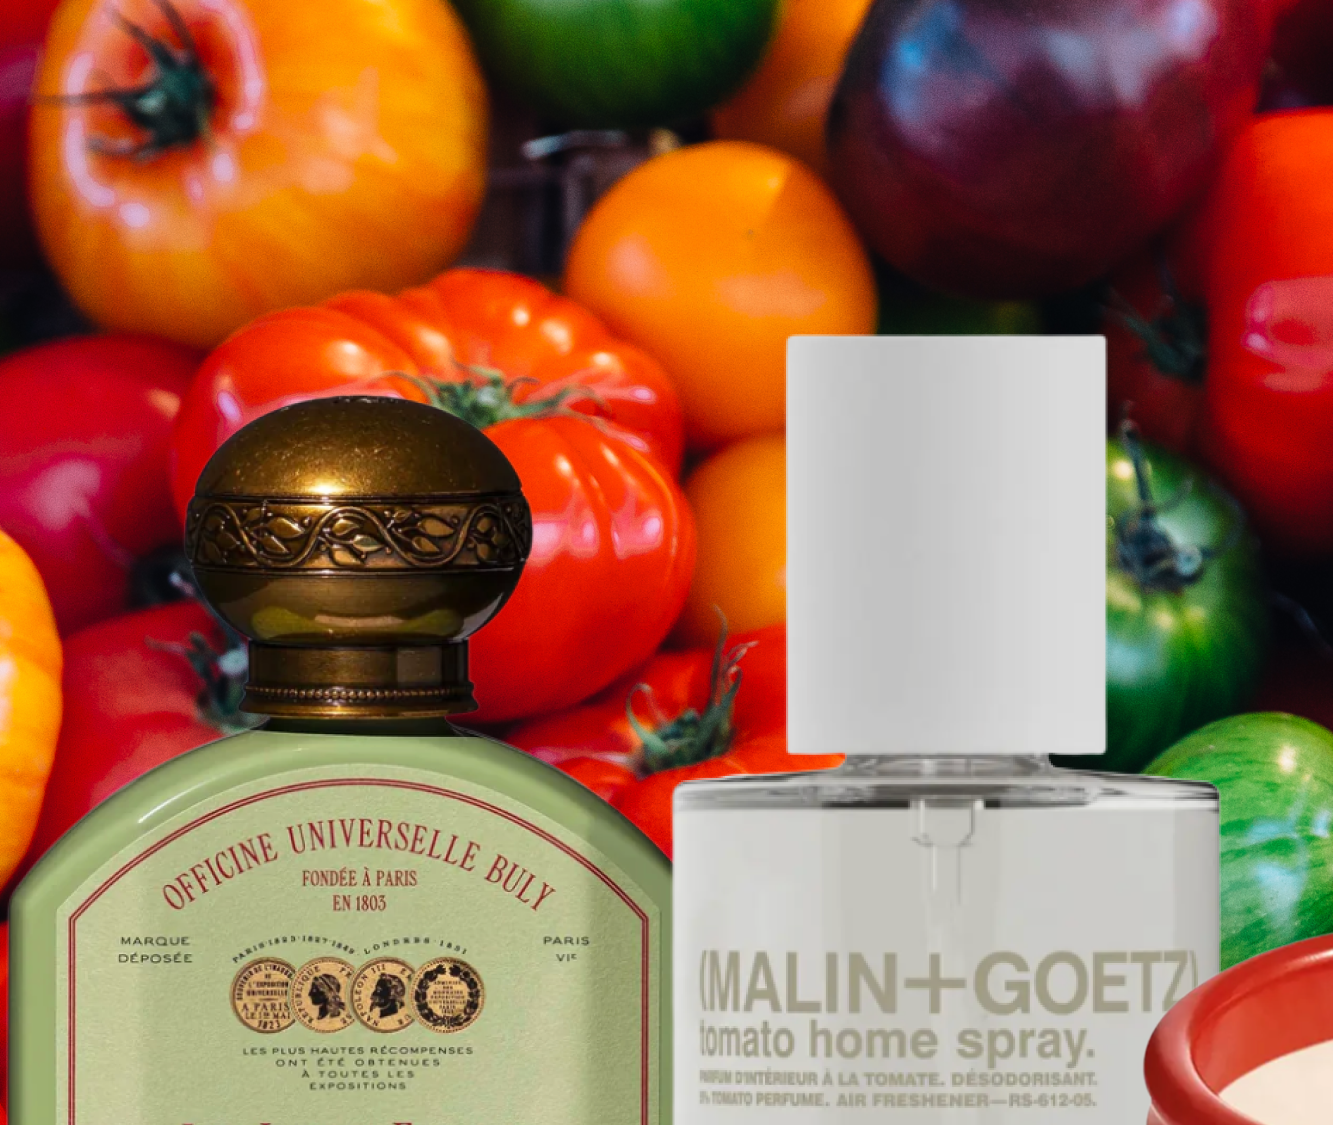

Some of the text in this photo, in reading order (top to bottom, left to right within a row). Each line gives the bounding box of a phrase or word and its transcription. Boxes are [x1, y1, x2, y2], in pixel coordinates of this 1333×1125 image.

[163, 818, 556, 912] OFFICINE UNIVERSELLE BULY
[302, 867, 418, 887] FONDÉE À PARIS
[332, 895, 386, 911] EN 1803
[121, 936, 190, 946] MARQUE
[543, 936, 590, 946] PARIS
[118, 951, 193, 964] DÉPOSÉE
[700, 1019, 1096, 1068] tomato home spray.
[243, 1046, 473, 1055] LES PLUS HAUTES RÉCOMPENSES
[275, 1057, 441, 1067] ONT ÉTÉ OBTENUES
[301, 1069, 310, 1078] À
[822, 1068, 833, 1086] À
[838, 1071, 859, 1086] LA
[864, 1072, 945, 1087] TOMATE.
[952, 1067, 1098, 1087] DÉSODORISANT.
[309, 1082, 407, 1090] EXPOSITIONS
[712, 1091, 752, 1106] TOMATO
[756, 1092, 830, 1107] PERFUME.
[836, 1093, 867, 1107] AIR
